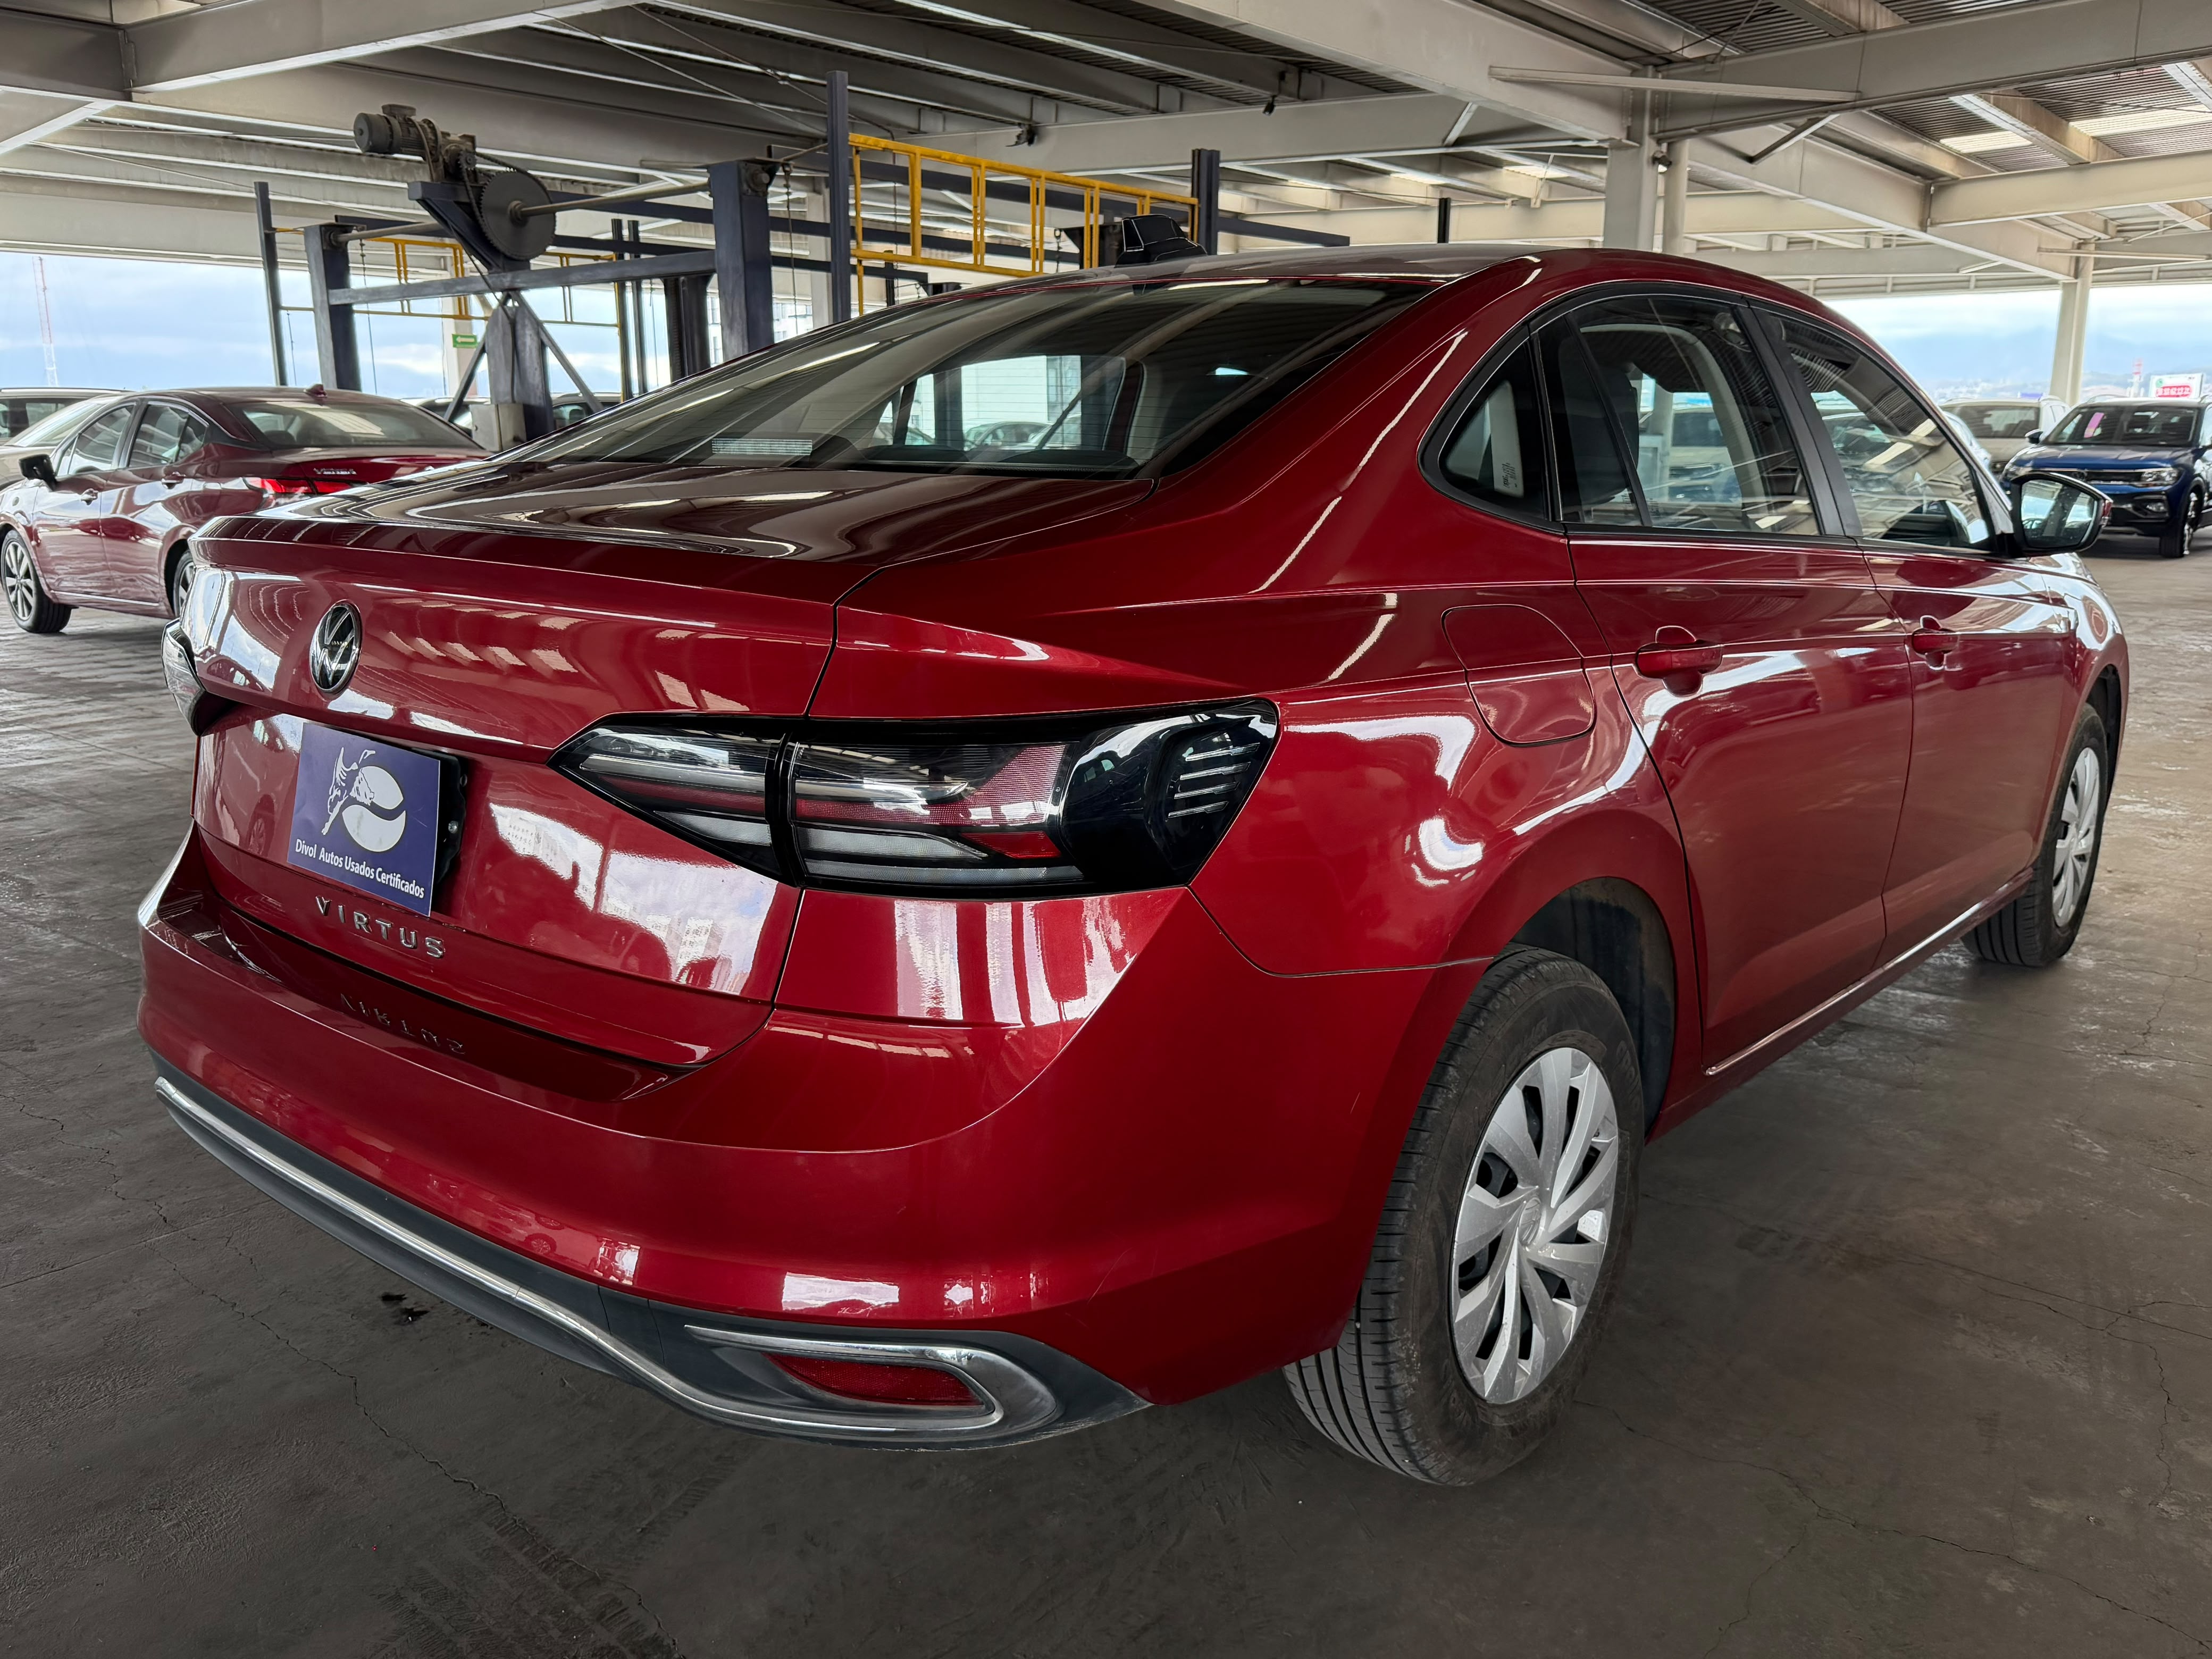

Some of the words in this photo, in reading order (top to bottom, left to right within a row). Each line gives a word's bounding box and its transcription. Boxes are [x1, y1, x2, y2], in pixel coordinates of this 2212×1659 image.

[295, 839, 317, 858] Divol
[319, 848, 343, 868] Autos
[345, 856, 375, 879] Usados
[375, 868, 424, 898] Certificados
[315, 896, 445, 958] VIRTUS
